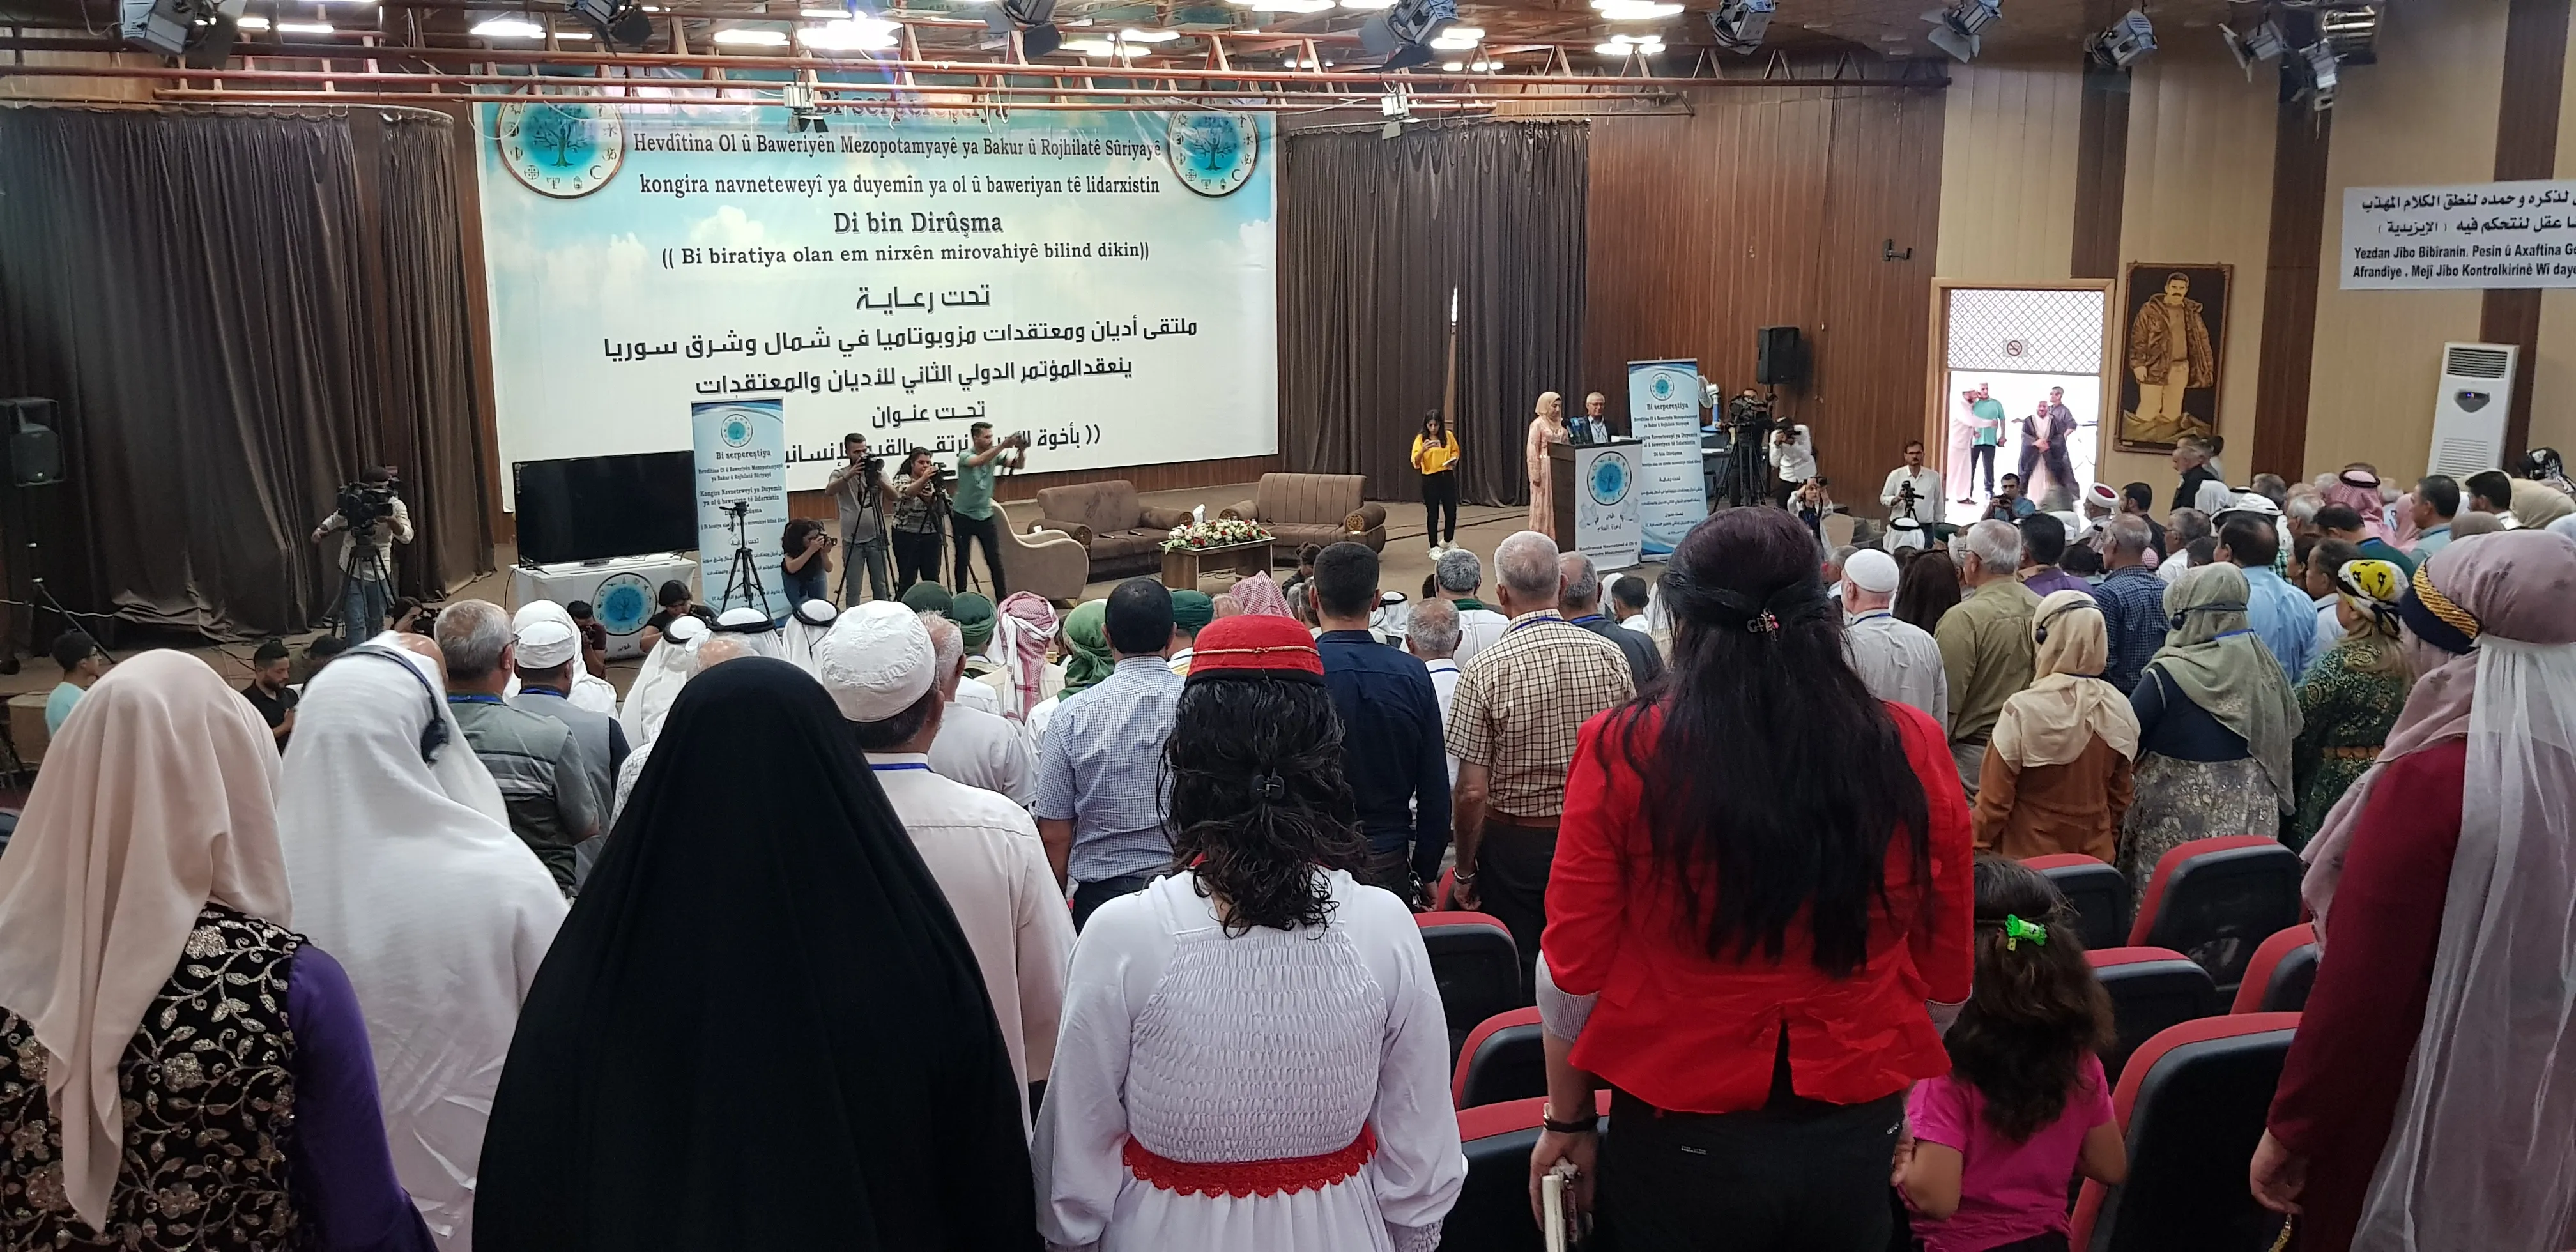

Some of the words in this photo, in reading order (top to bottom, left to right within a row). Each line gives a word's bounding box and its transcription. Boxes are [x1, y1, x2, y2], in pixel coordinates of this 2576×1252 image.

[634, 133, 714, 151] Hevdîtina
[719, 134, 737, 151] Ol
[742, 134, 751, 152] û
[756, 135, 835, 158] Baweriyên
[841, 136, 958, 158] Mezopotamyayê
[962, 142, 978, 159] ya
[983, 138, 1023, 155] Bakur
[1028, 138, 1036, 155] û
[1041, 139, 1101, 160] Rojhilatê
[640, 174, 709, 198] kongira
[715, 174, 822, 198] navneteweyî
[828, 180, 847, 198] ya
[854, 174, 923, 198] duyemîn
[929, 180, 947, 198] ya
[953, 175, 967, 192] ol
[972, 175, 981, 193] û
[986, 175, 1062, 198] baweriyan
[1067, 176, 1081, 193] tê
[1086, 176, 1160, 193] lidarxistin
[834, 212, 860, 234] Di
[866, 211, 903, 234] bin
[911, 211, 1004, 238] Dirûşma
[681, 248, 702, 264] Bi
[709, 247, 786, 267] biratiya
[793, 246, 834, 262] olan
[841, 250, 868, 261] em
[875, 245, 934, 261] nirxên
[941, 243, 1038, 263] mirovahiyê
[1044, 243, 1092, 257] bilind
[765, 326, 830, 355] شمال
[877, 326, 976, 351] مزوبوتاميا
[983, 323, 1084, 343] ومعتقدات
[1092, 315, 1137, 342] أديان
[1144, 318, 1197, 340] ملتقى
[604, 339, 677, 362] سوريا
[686, 330, 756, 358] وشرق
[839, 330, 869, 357] في
[696, 372, 820, 394] والمعتقدات
[828, 367, 895, 392] للأديان
[902, 362, 951, 394] الثاني
[958, 362, 1015, 392] الدولي
